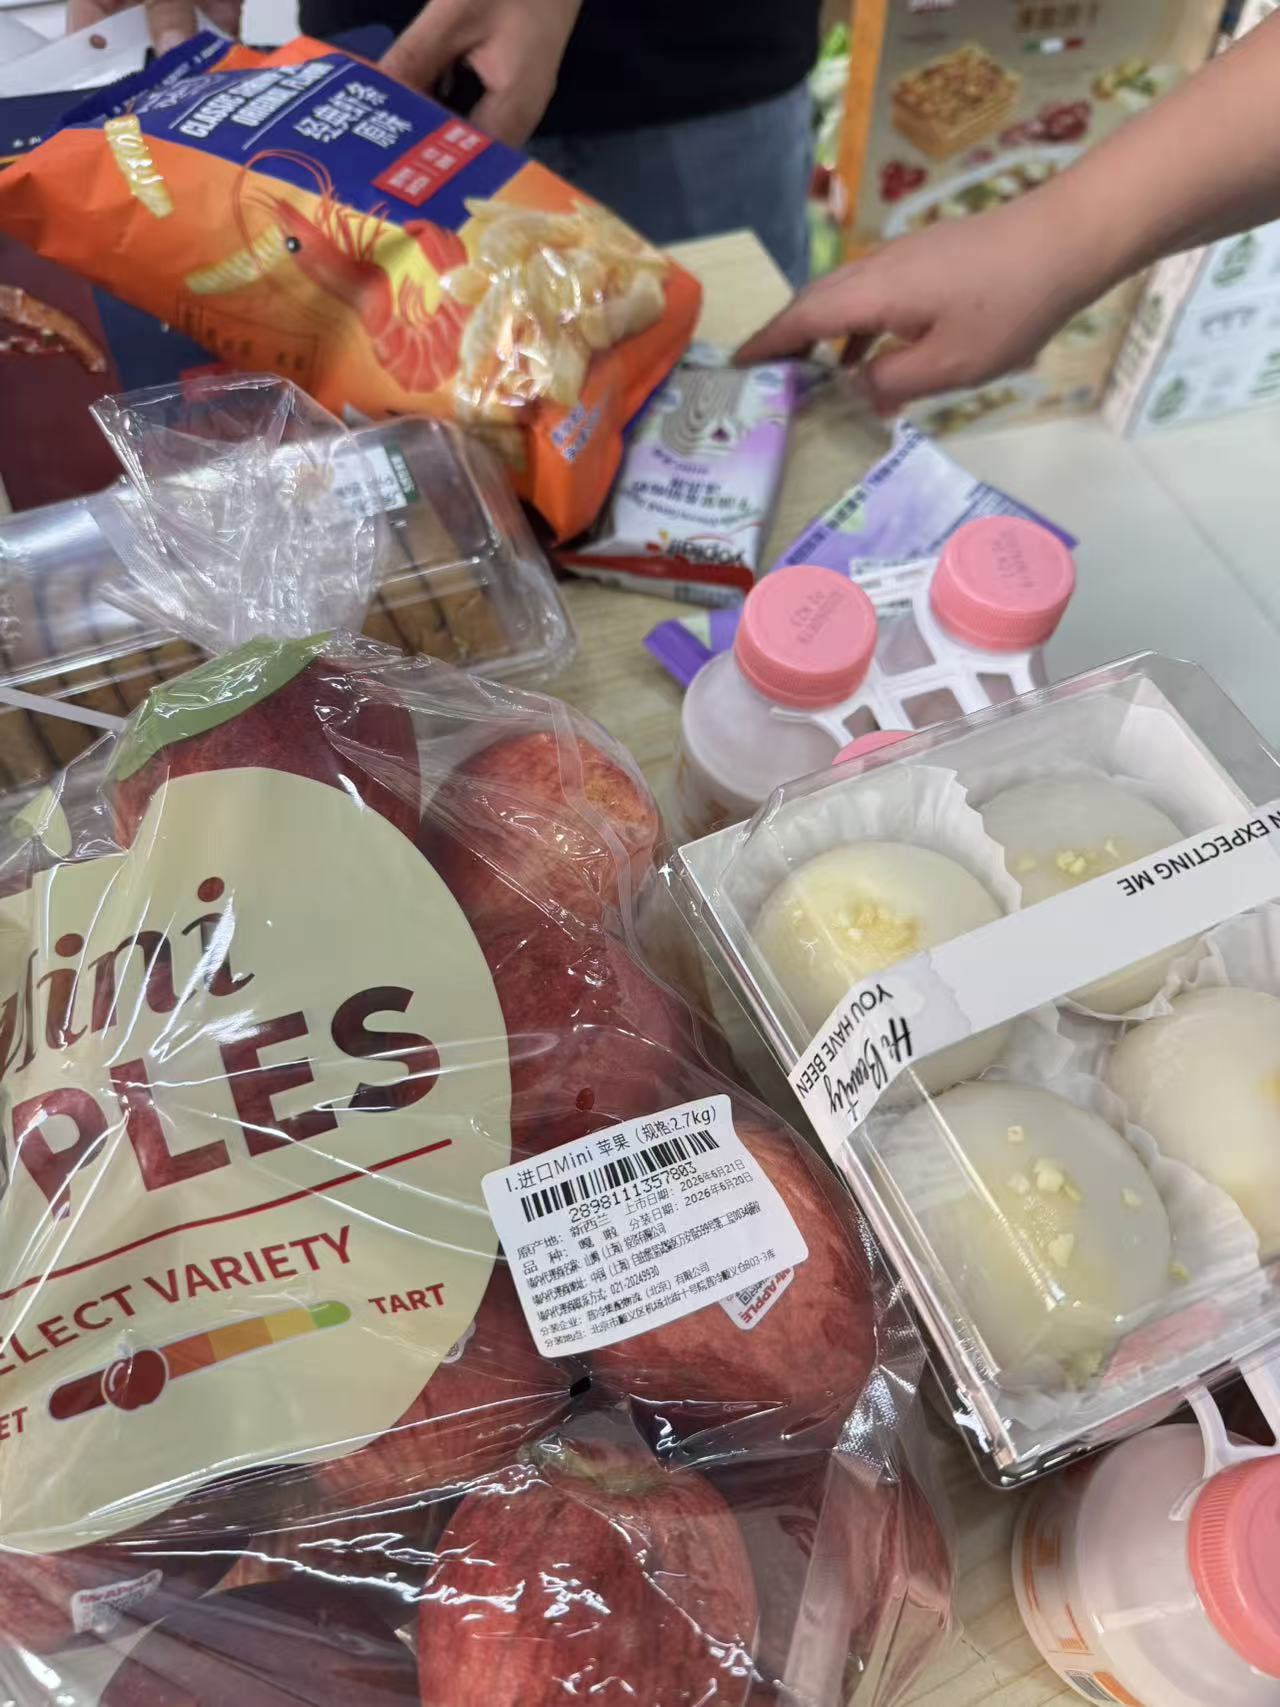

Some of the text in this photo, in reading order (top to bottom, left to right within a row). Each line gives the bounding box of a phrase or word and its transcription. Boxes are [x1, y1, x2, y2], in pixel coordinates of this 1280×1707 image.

[179, 92, 247, 138] CLASSIC
[1153, 819, 1270, 880] EXPECTING
[1116, 870, 1155, 896] ME
[795, 983, 894, 1100] YOU HAVE BEEN
[12, 985, 441, 1221] PLES
[823, 1037, 889, 1122] Beauty
[567, 1160, 699, 1223] 2898111357803
[143, 1225, 352, 1304] VARIETY
[367, 1282, 446, 1316] TART
[739, 1281, 779, 1324] APPLE
